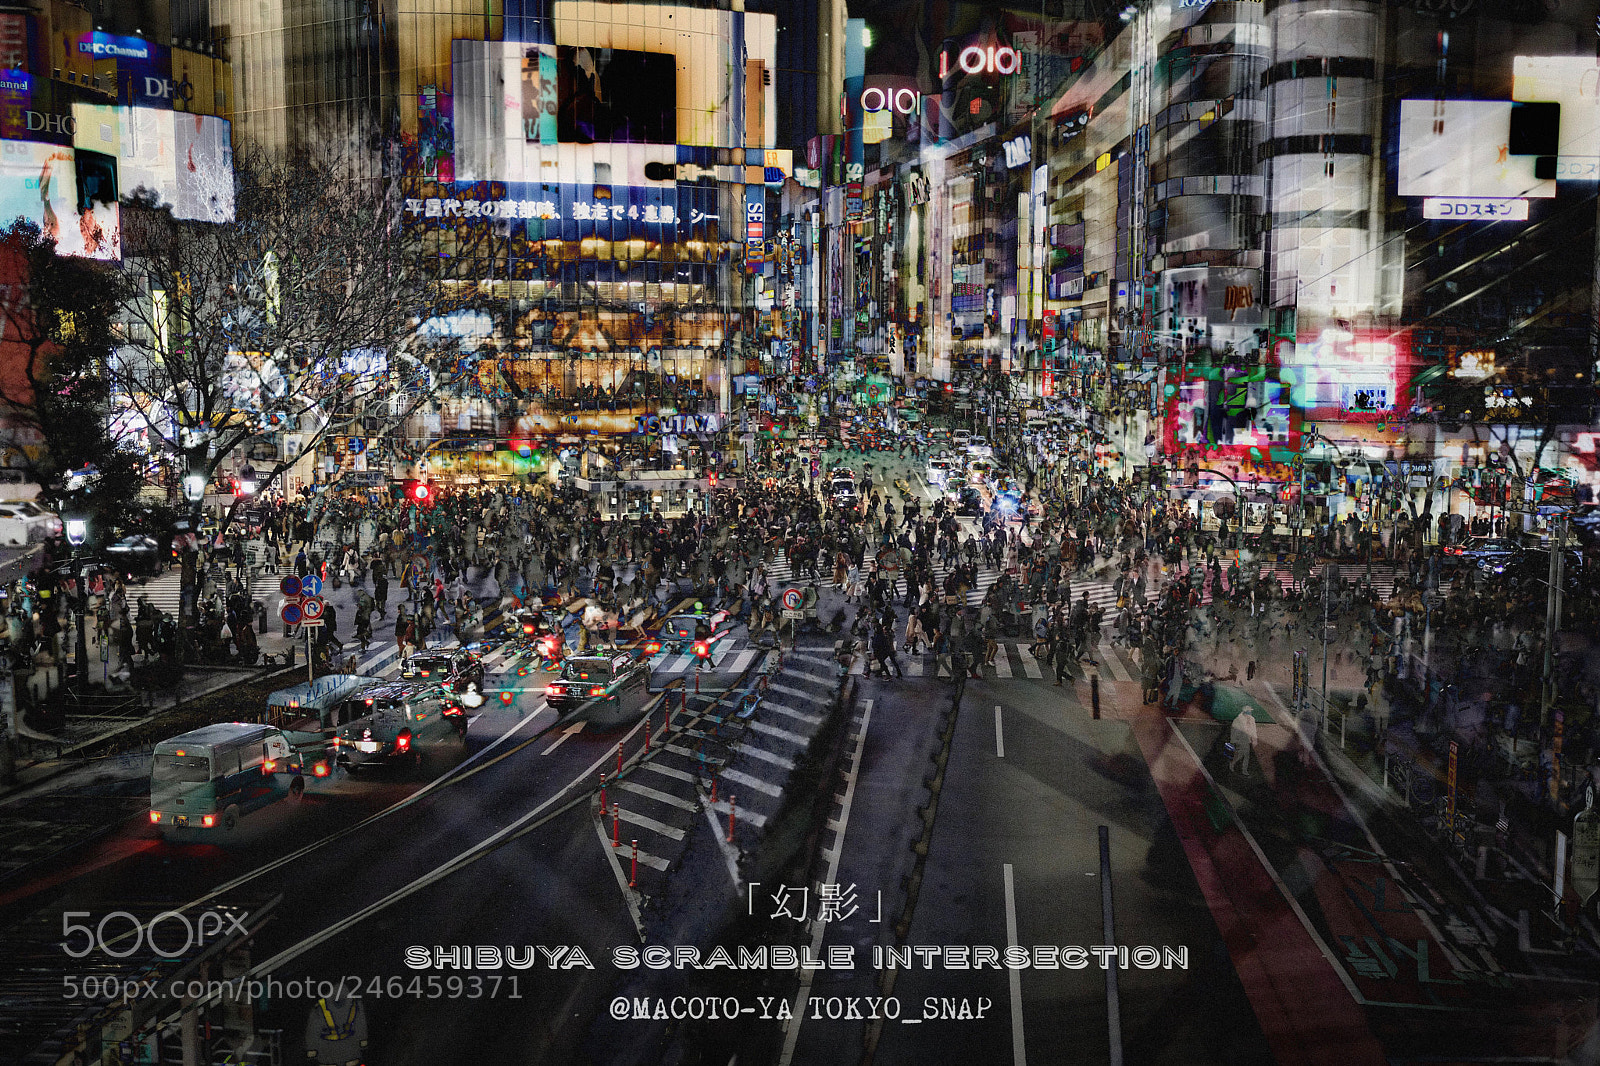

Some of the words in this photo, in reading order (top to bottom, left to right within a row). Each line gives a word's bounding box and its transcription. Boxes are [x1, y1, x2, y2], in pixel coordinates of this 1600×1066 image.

[79, 42, 104, 53] DHC
[105, 44, 148, 58] Channel
[144, 76, 193, 101] DHC
[25, 110, 77, 136] DHC
[1440, 203, 1512, 216] コロスキン
[748, 202, 763, 261] SEIBU
[635, 415, 718, 434] TSUTAYA
